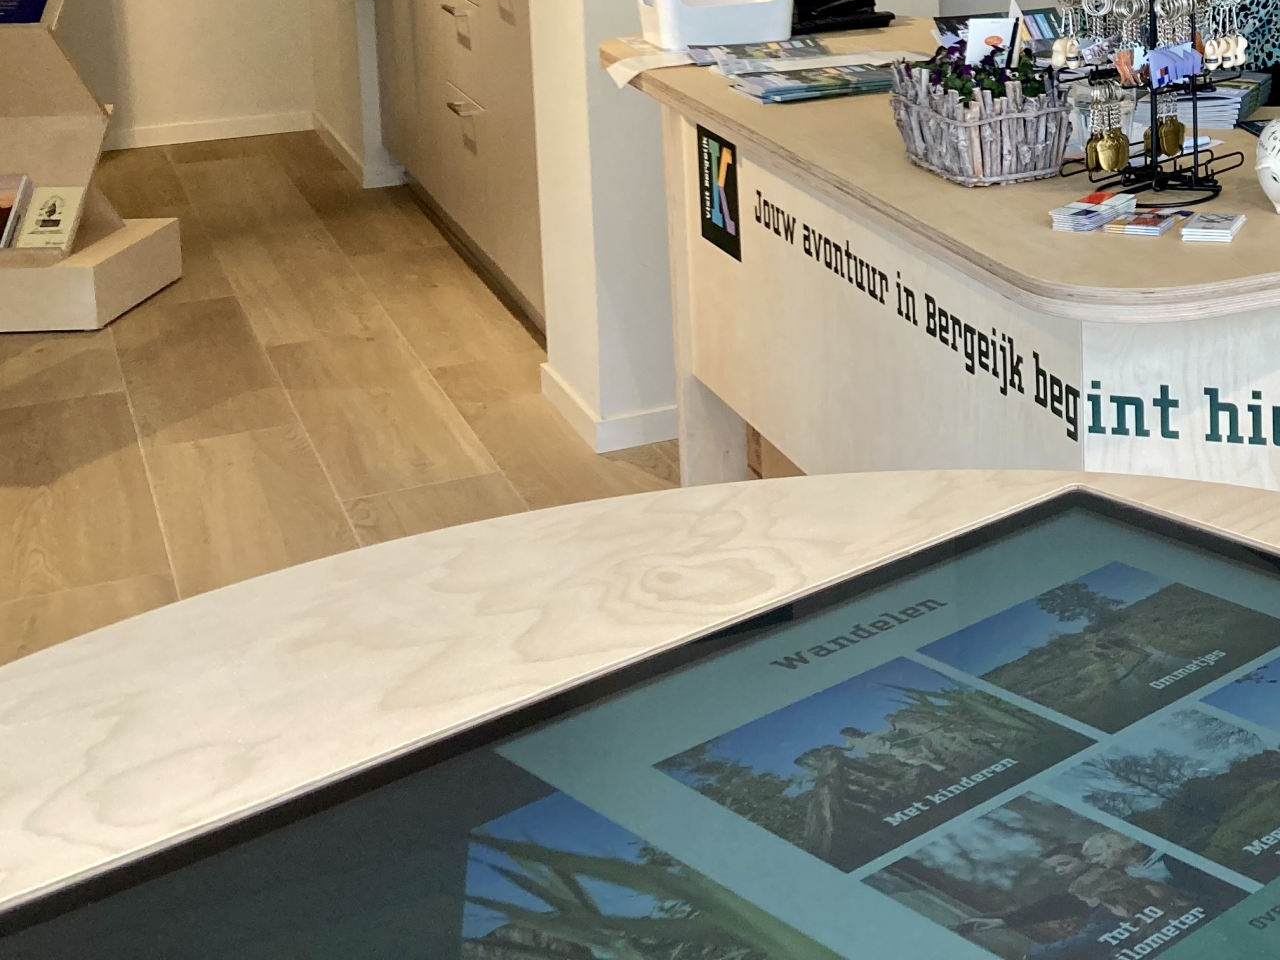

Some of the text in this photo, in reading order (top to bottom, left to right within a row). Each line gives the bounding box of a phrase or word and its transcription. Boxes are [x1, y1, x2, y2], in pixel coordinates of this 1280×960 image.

[754, 189, 796, 245] Jouw
[802, 223, 889, 305] avontuur
[896, 270, 918, 326] in
[924, 292, 1025, 396] Bergeijk
[1032, 350, 1180, 442] begint
[769, 598, 948, 670] Wandelen
[1148, 649, 1227, 690] Ommetjes
[882, 757, 1019, 827] Met kinderen
[1097, 905, 1165, 946] Tot 10
[1114, 907, 1206, 960] ilometer
